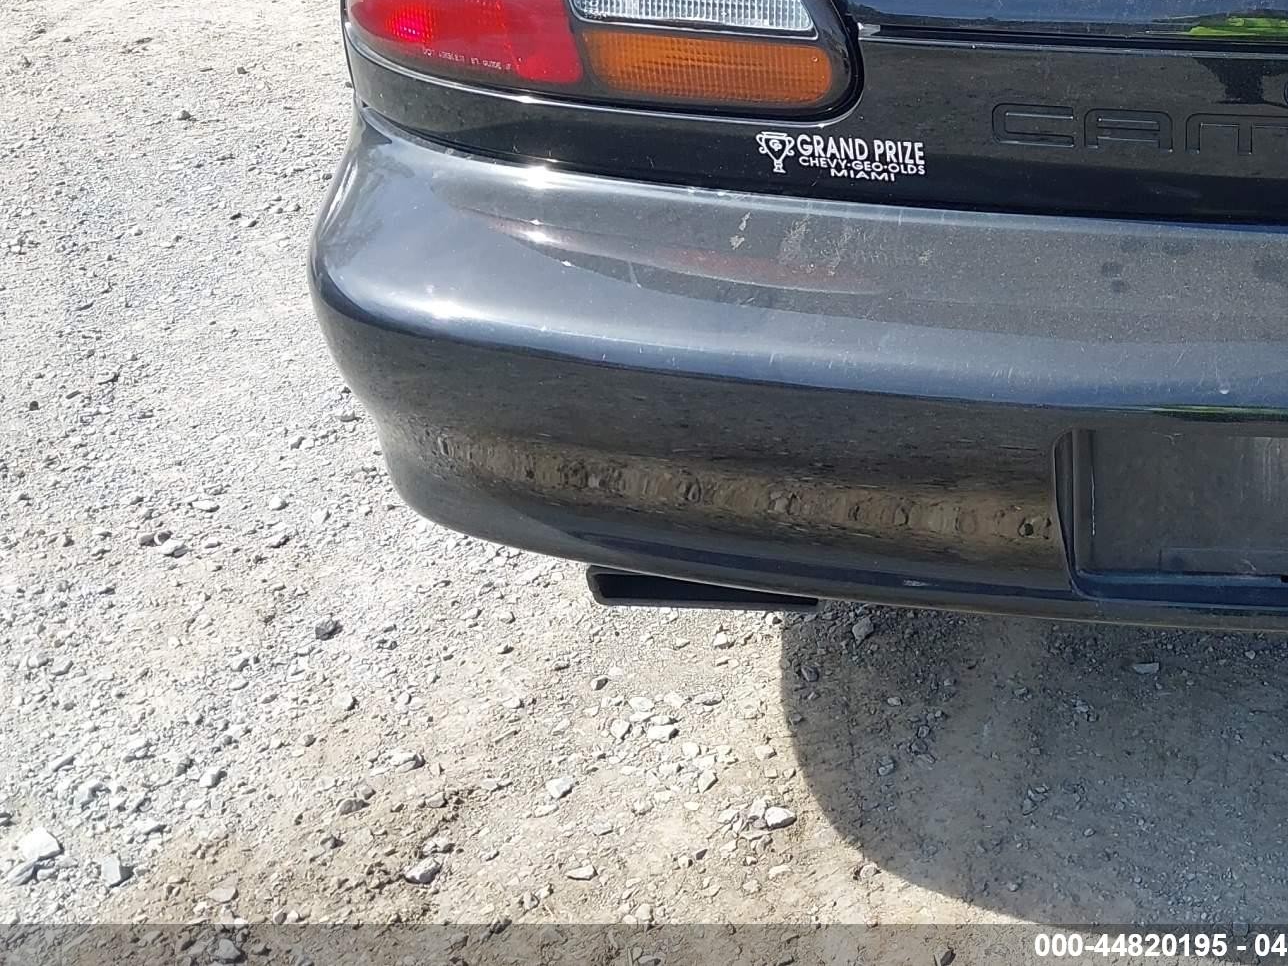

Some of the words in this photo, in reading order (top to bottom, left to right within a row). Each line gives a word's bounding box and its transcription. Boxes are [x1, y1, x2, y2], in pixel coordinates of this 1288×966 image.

[796, 134, 868, 161] GRAND
[873, 139, 926, 165] PRIZE
[830, 168, 896, 182] MIAMI
